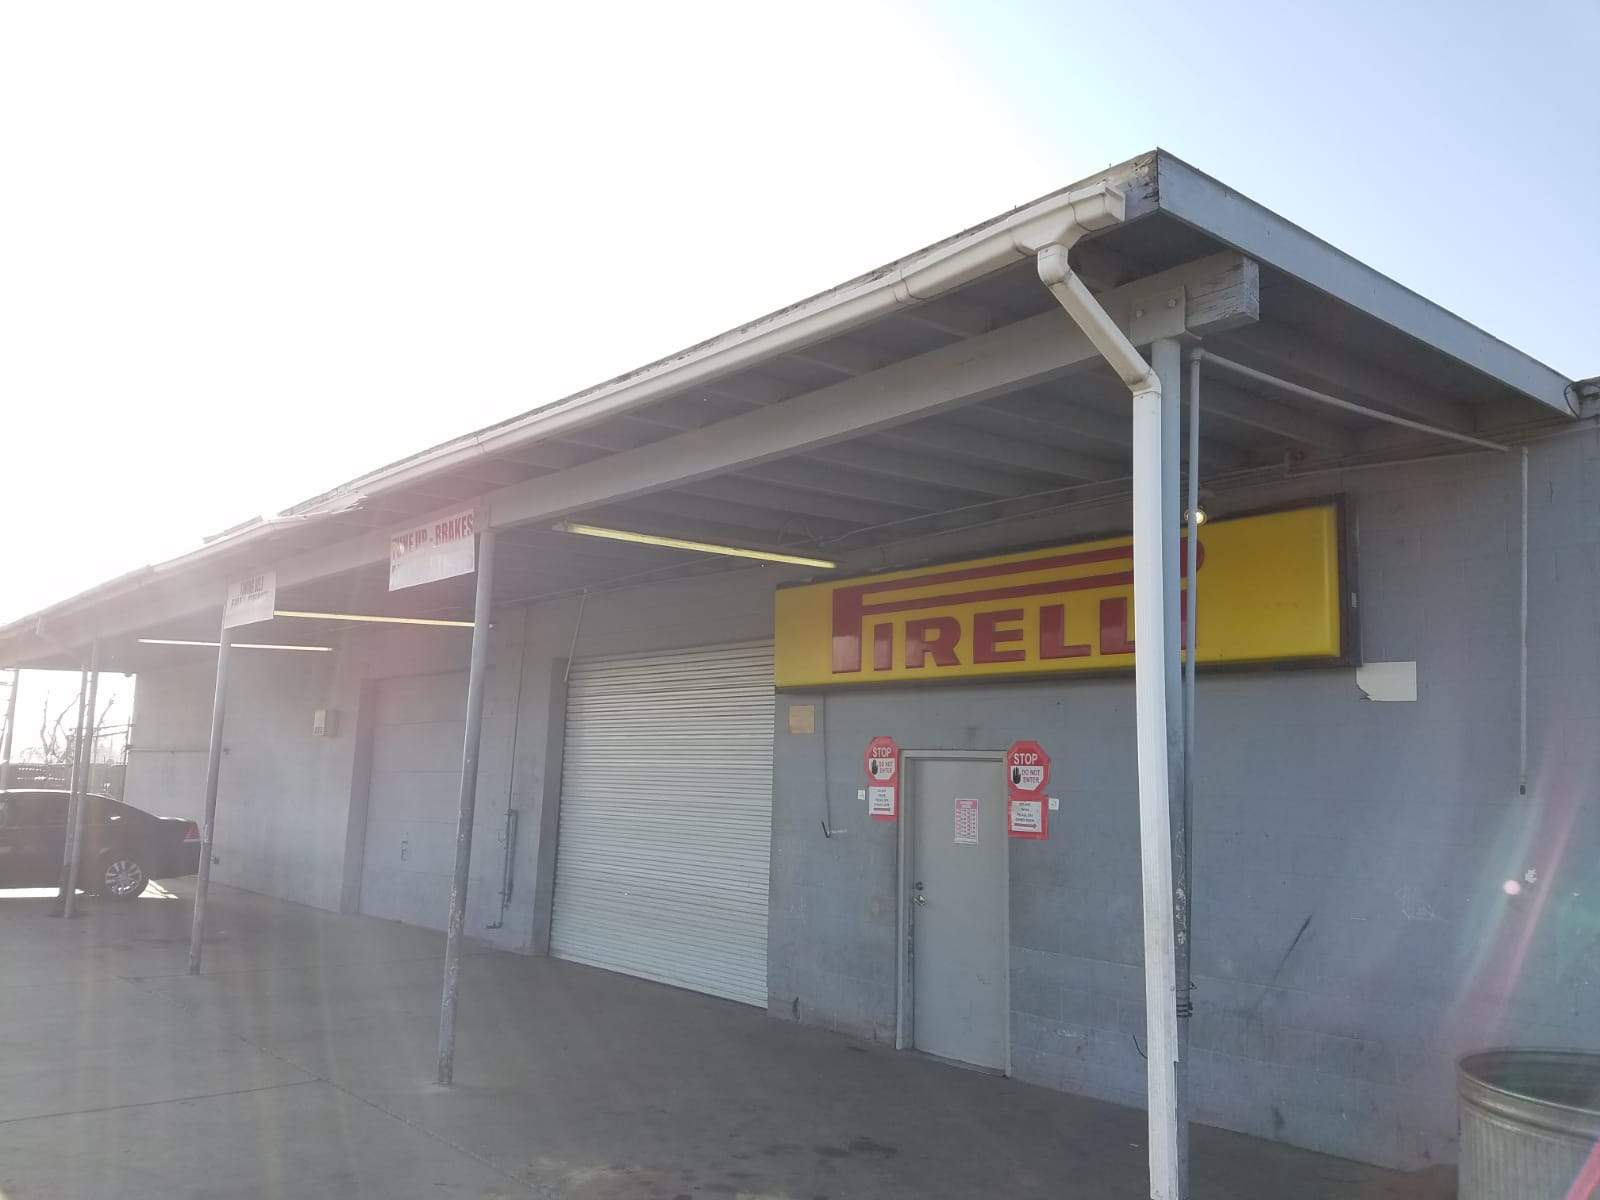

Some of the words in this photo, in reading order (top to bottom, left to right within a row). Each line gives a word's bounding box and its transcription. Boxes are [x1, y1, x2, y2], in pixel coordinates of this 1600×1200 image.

[435, 513, 474, 545] BRAKES
[872, 746, 892, 758] STOP
[1013, 752, 1038, 765] STOP
[1030, 769, 1040, 777] NOT
[1023, 776, 1040, 784] ENTER
